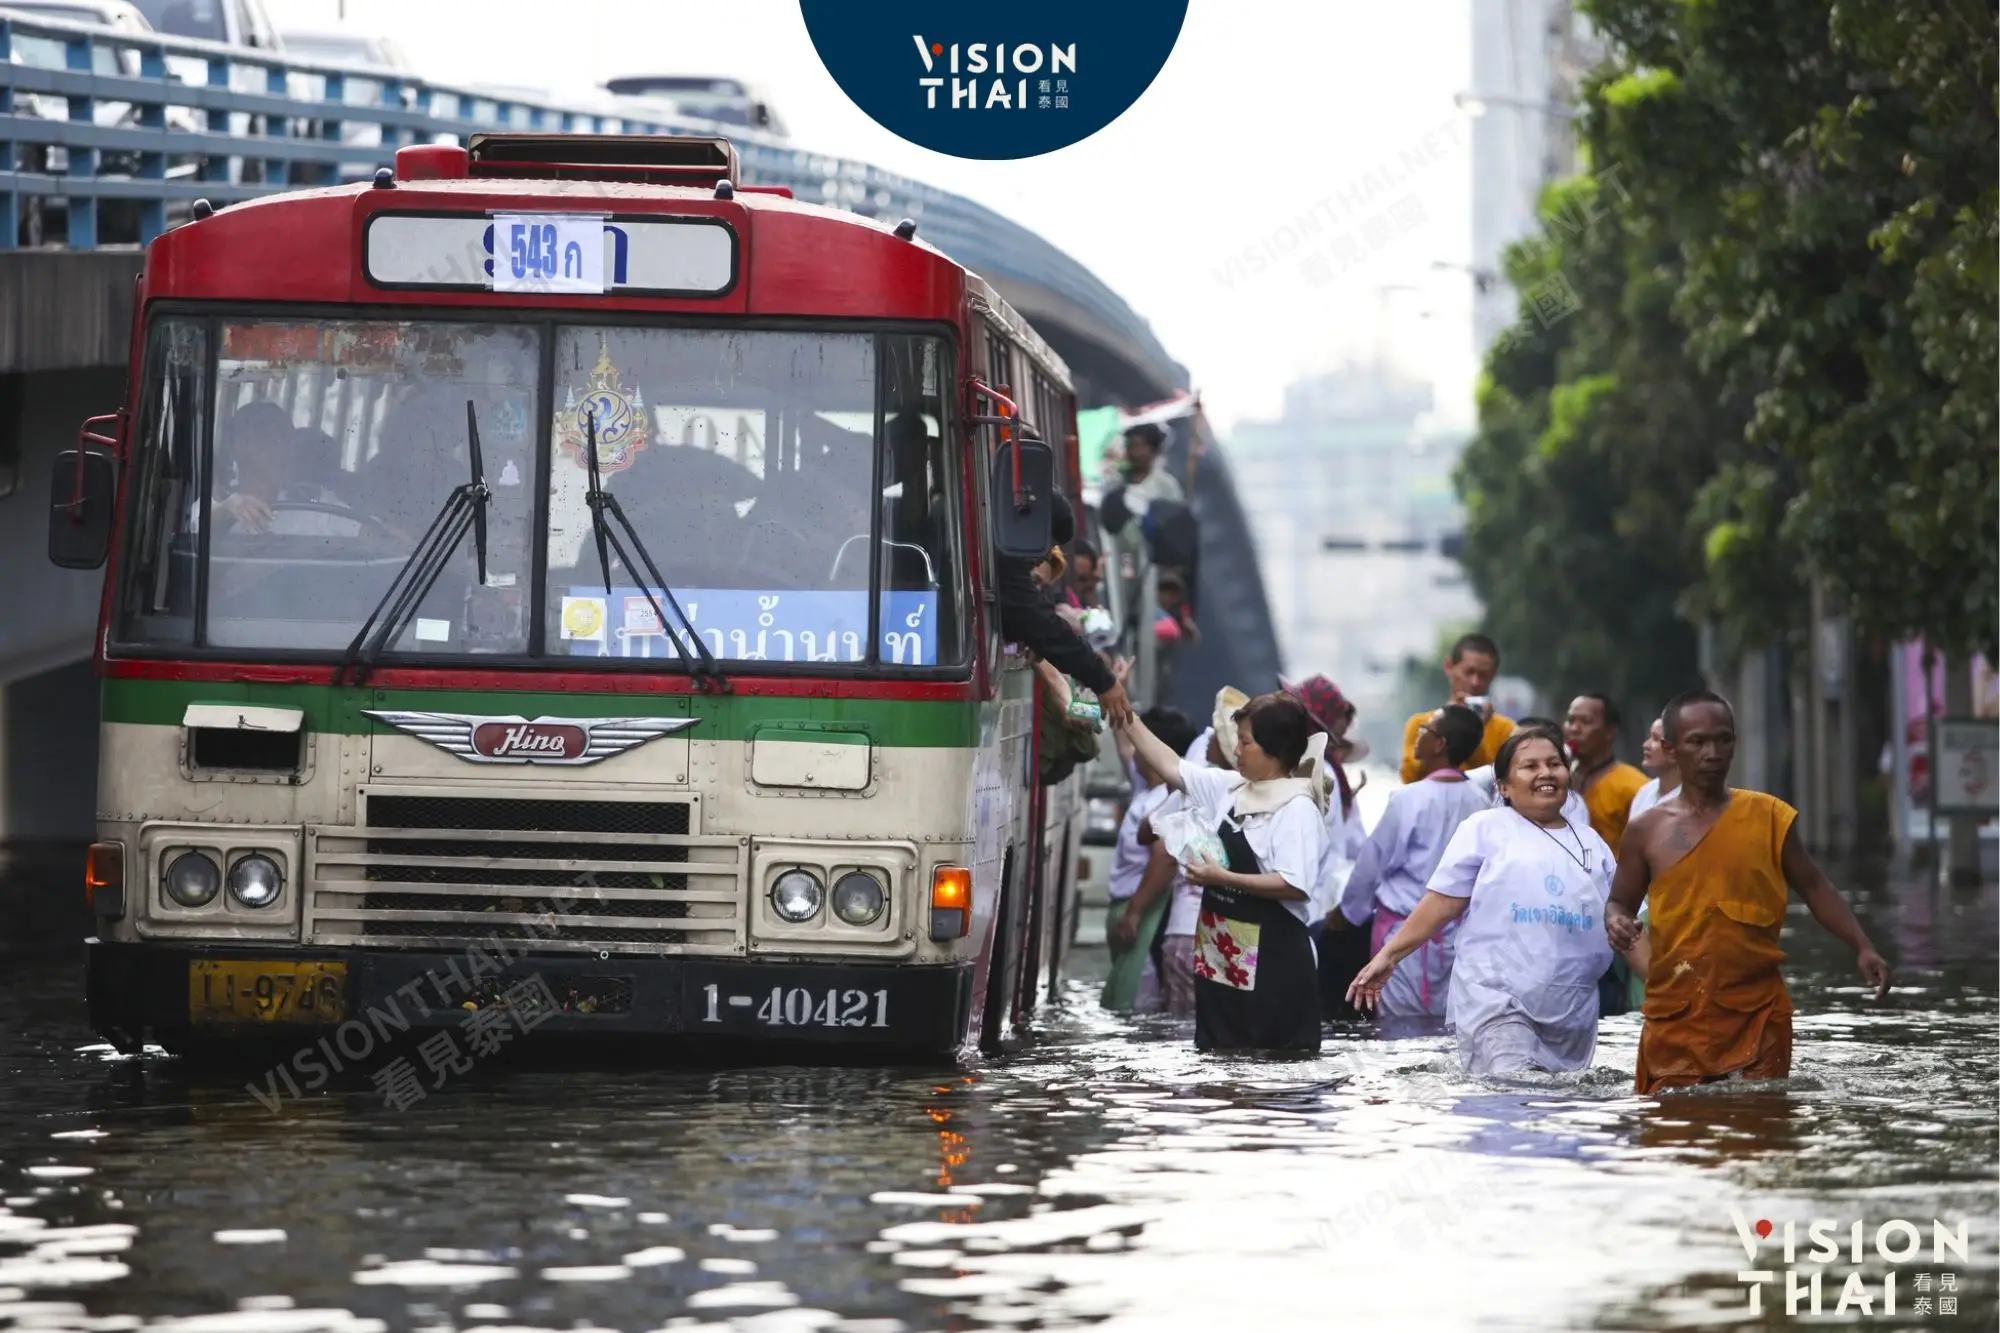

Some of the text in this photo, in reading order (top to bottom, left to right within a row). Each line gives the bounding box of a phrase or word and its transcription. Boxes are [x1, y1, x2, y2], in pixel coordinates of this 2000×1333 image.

[511, 223, 558, 280] 543
[565, 240, 582, 280] ก
[493, 724, 566, 756] Hino
[701, 983, 891, 1028] 1-40421
